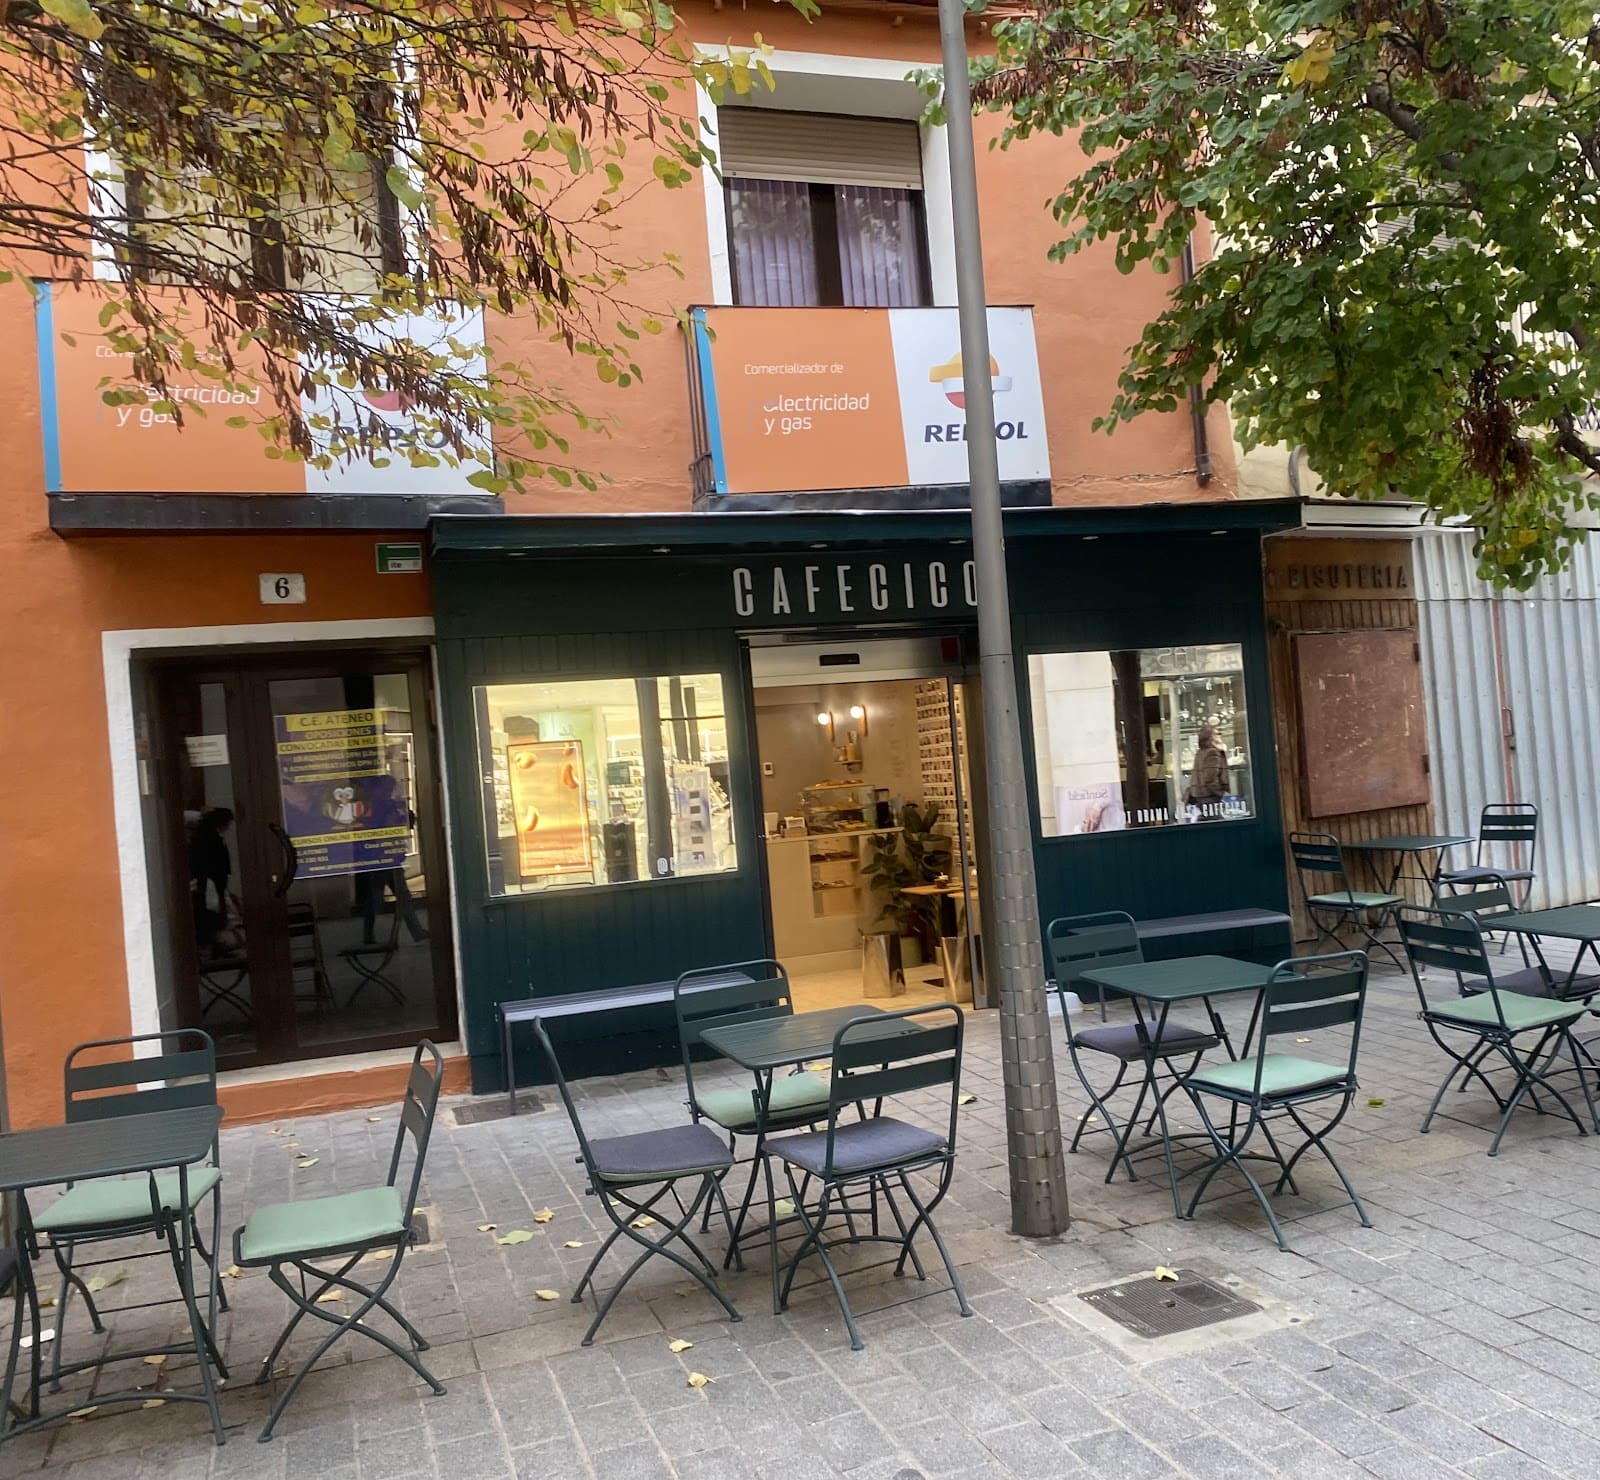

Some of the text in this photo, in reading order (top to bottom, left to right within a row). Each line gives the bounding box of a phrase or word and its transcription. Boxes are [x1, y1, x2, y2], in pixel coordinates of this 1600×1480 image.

[744, 362, 844, 376] Comercializador de
[116, 406, 132, 428] y
[764, 416, 813, 436] y gas
[924, 421, 1028, 443] REOL
[274, 577, 290, 599] 6
[733, 561, 978, 617] CAFECICO
[326, 711, 374, 726] ATENEO
